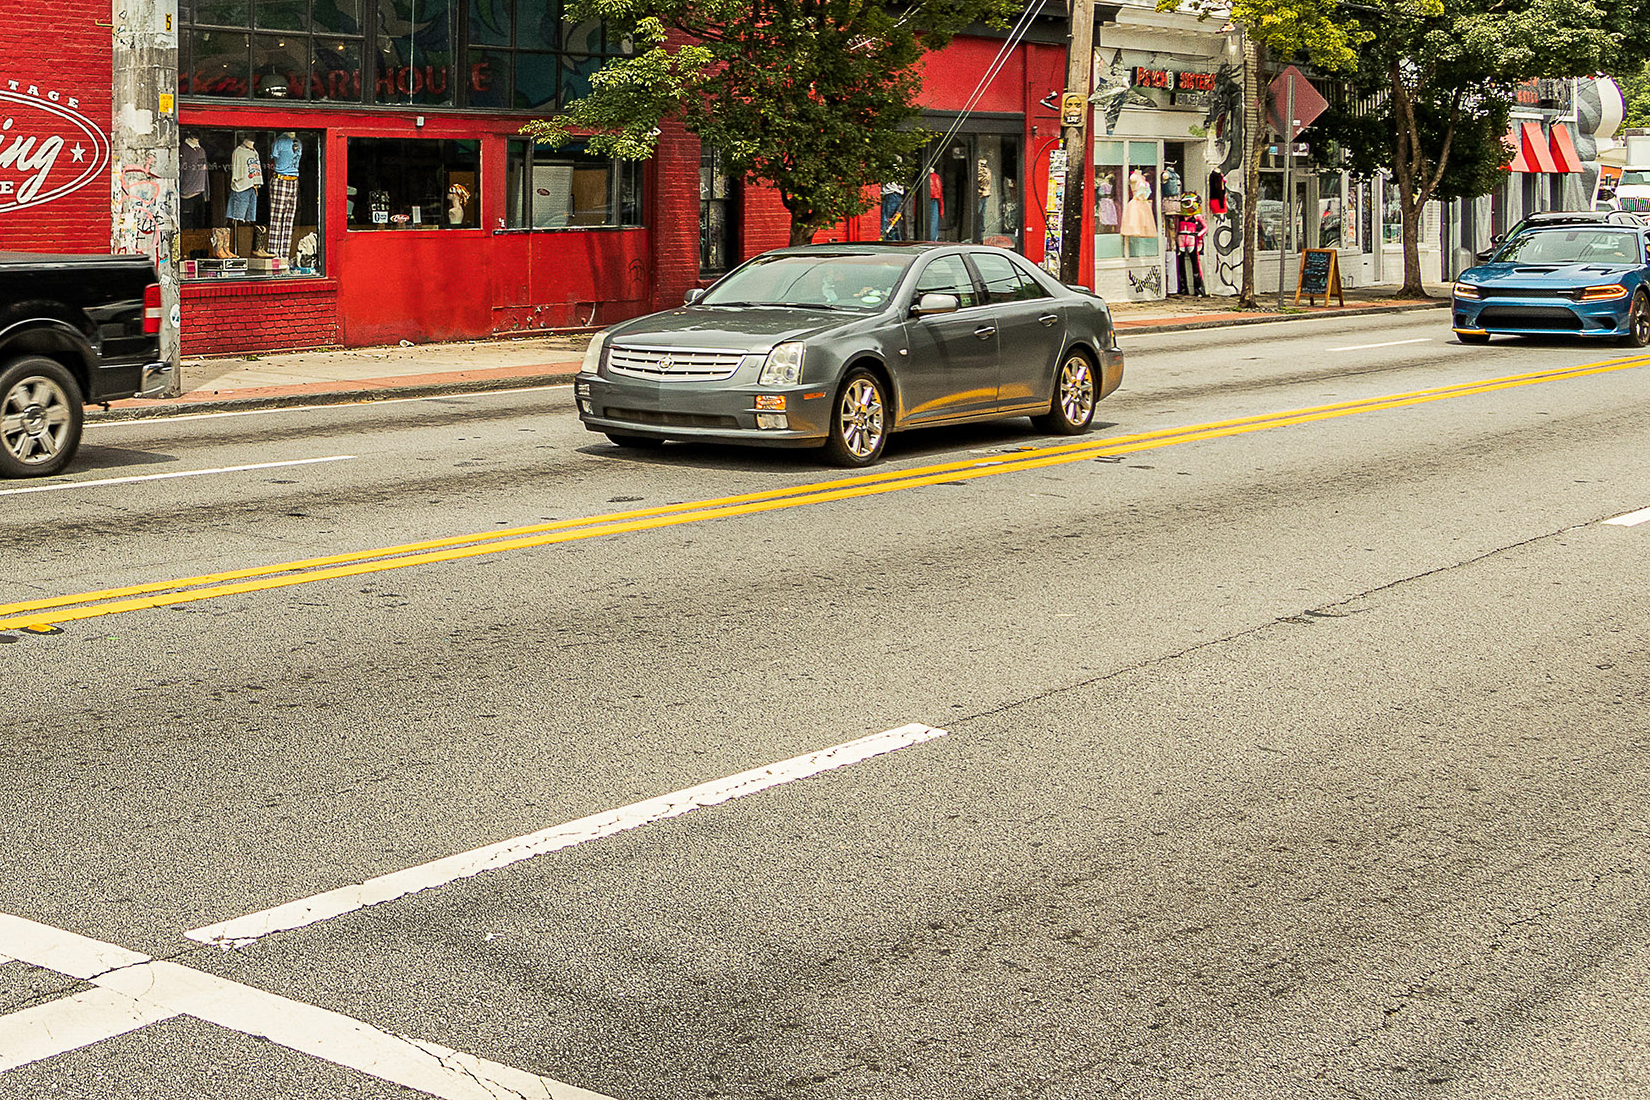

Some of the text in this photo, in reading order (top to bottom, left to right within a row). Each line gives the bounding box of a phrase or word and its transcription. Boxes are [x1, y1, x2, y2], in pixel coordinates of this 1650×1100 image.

[166, 14, 173, 31] 5
[287, 62, 489, 98] WARHOUE
[1137, 66, 1217, 92] PSYCHO SISTERS
